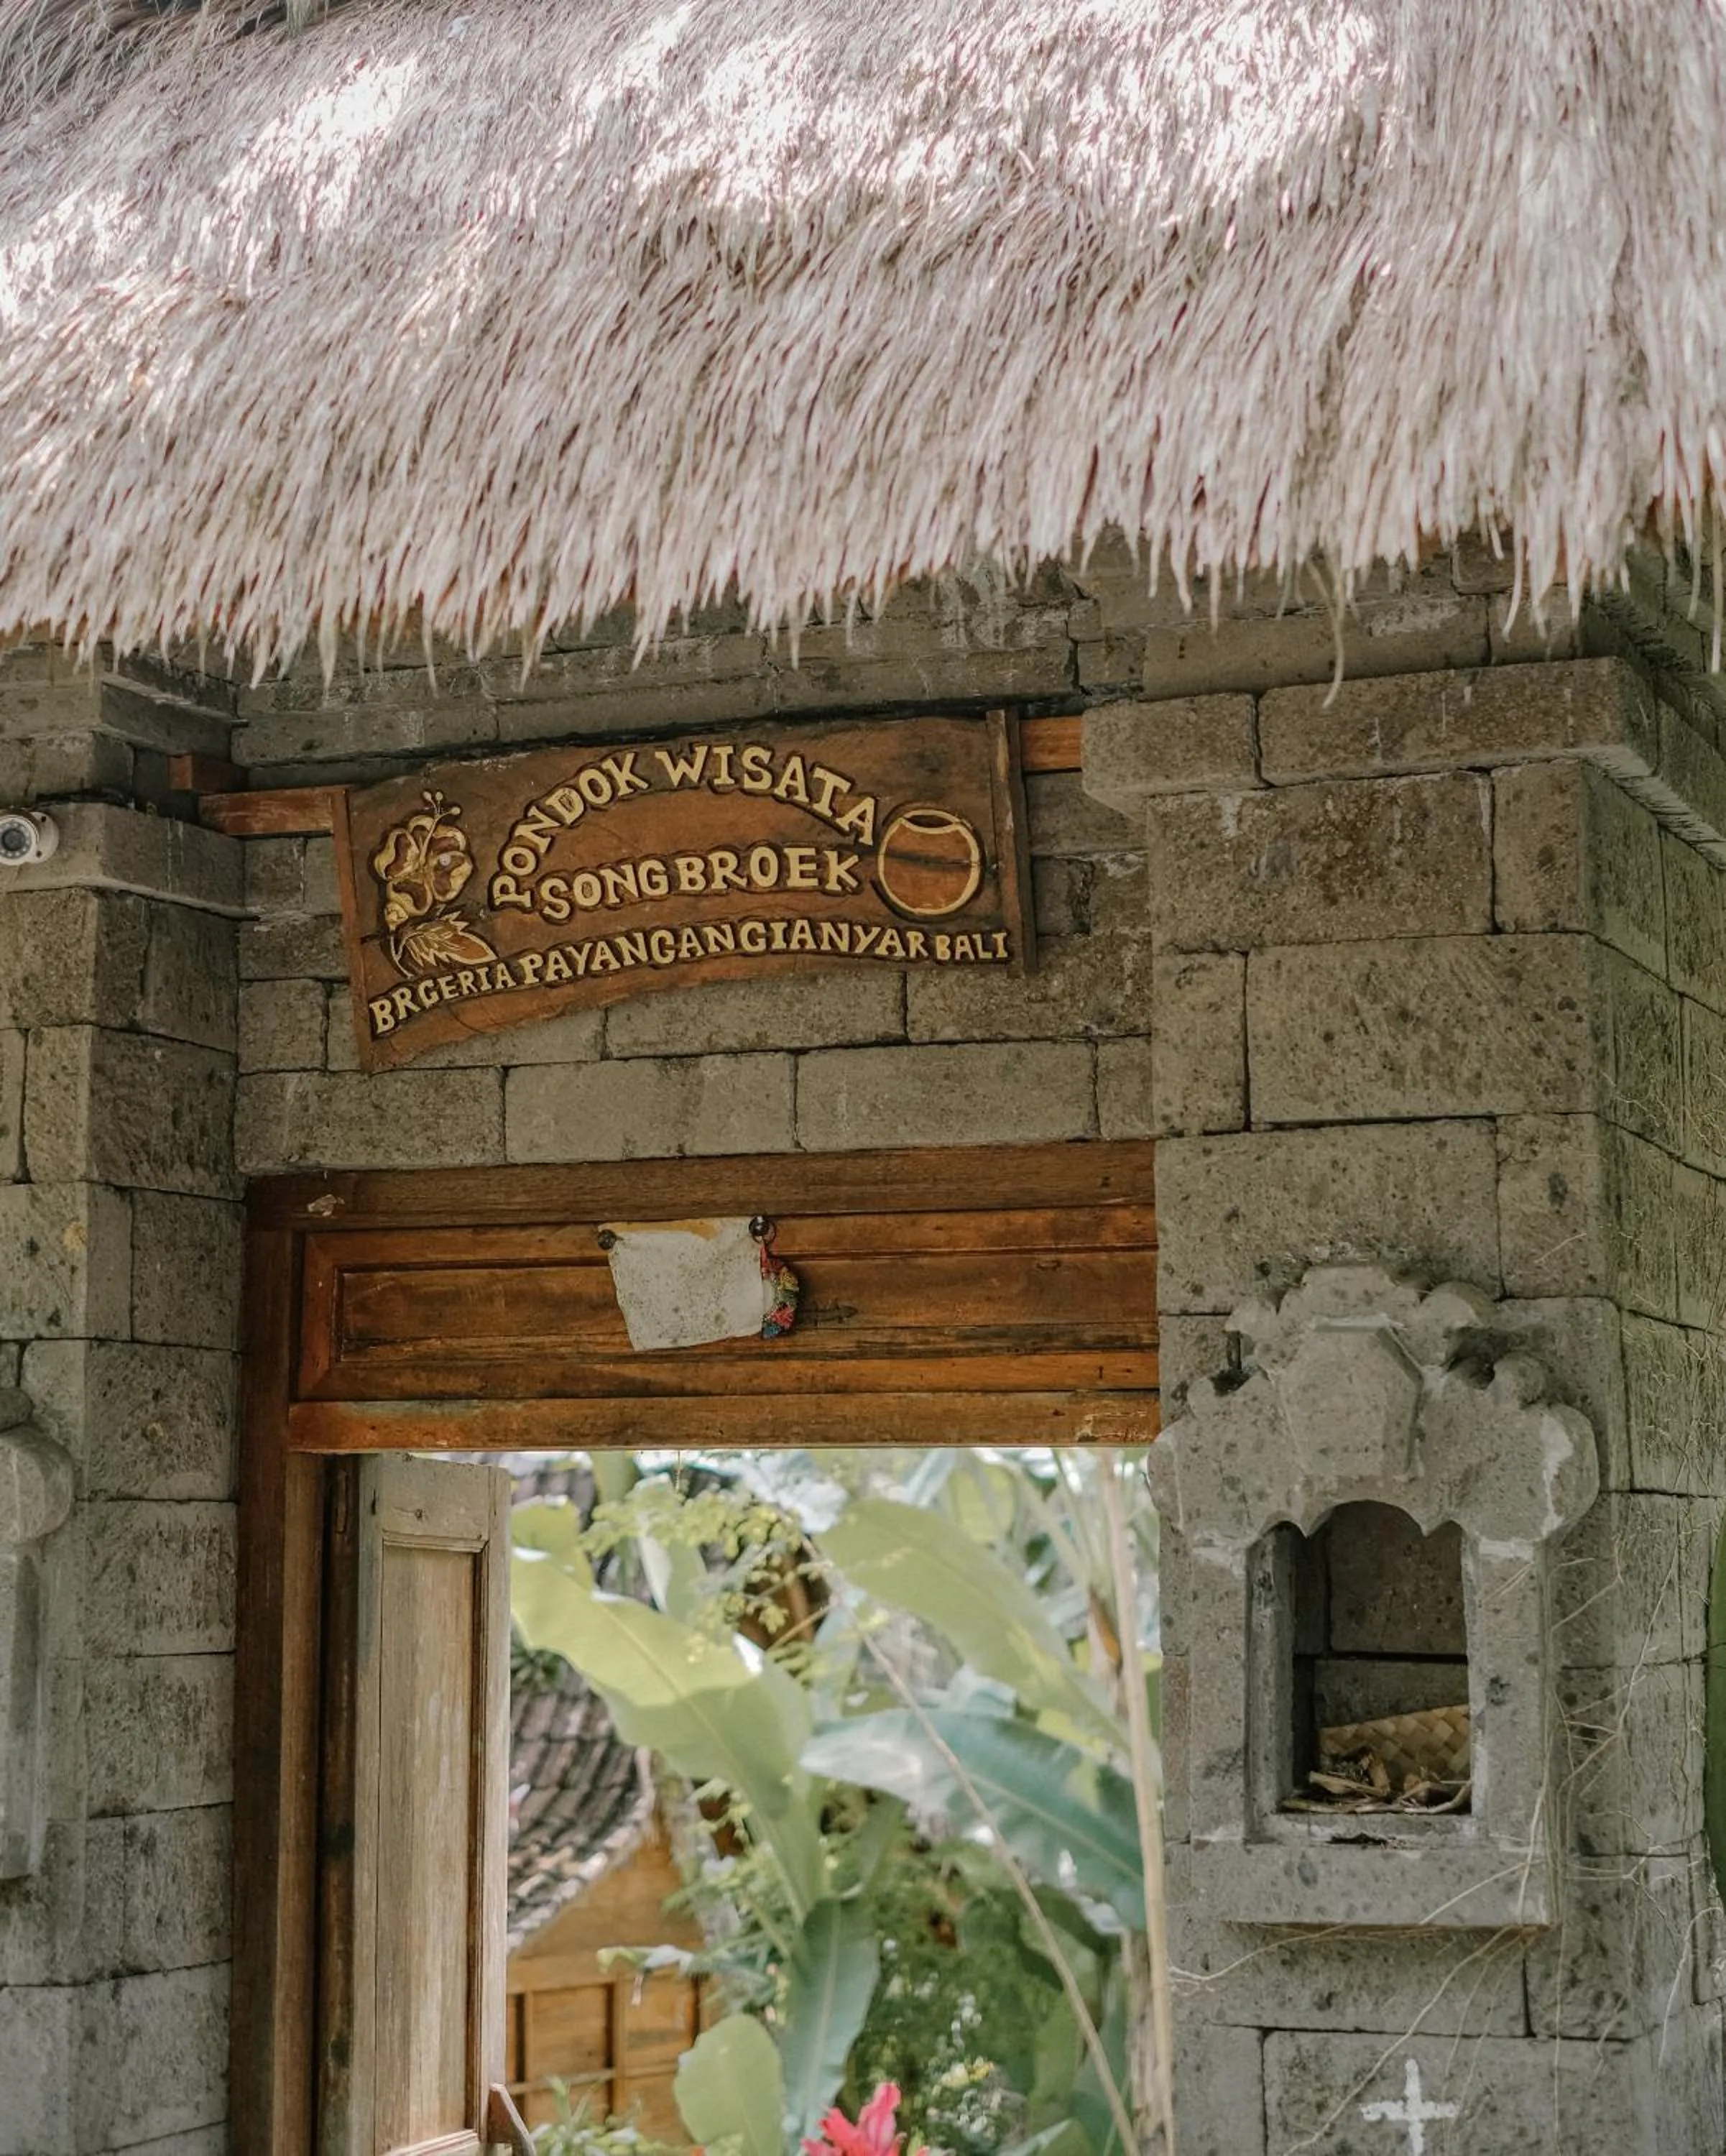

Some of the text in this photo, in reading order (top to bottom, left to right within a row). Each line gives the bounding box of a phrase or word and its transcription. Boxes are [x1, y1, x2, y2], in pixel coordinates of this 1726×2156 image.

[492, 745, 878, 909] PONDOK WISATA
[936, 931, 1008, 961] BALI
